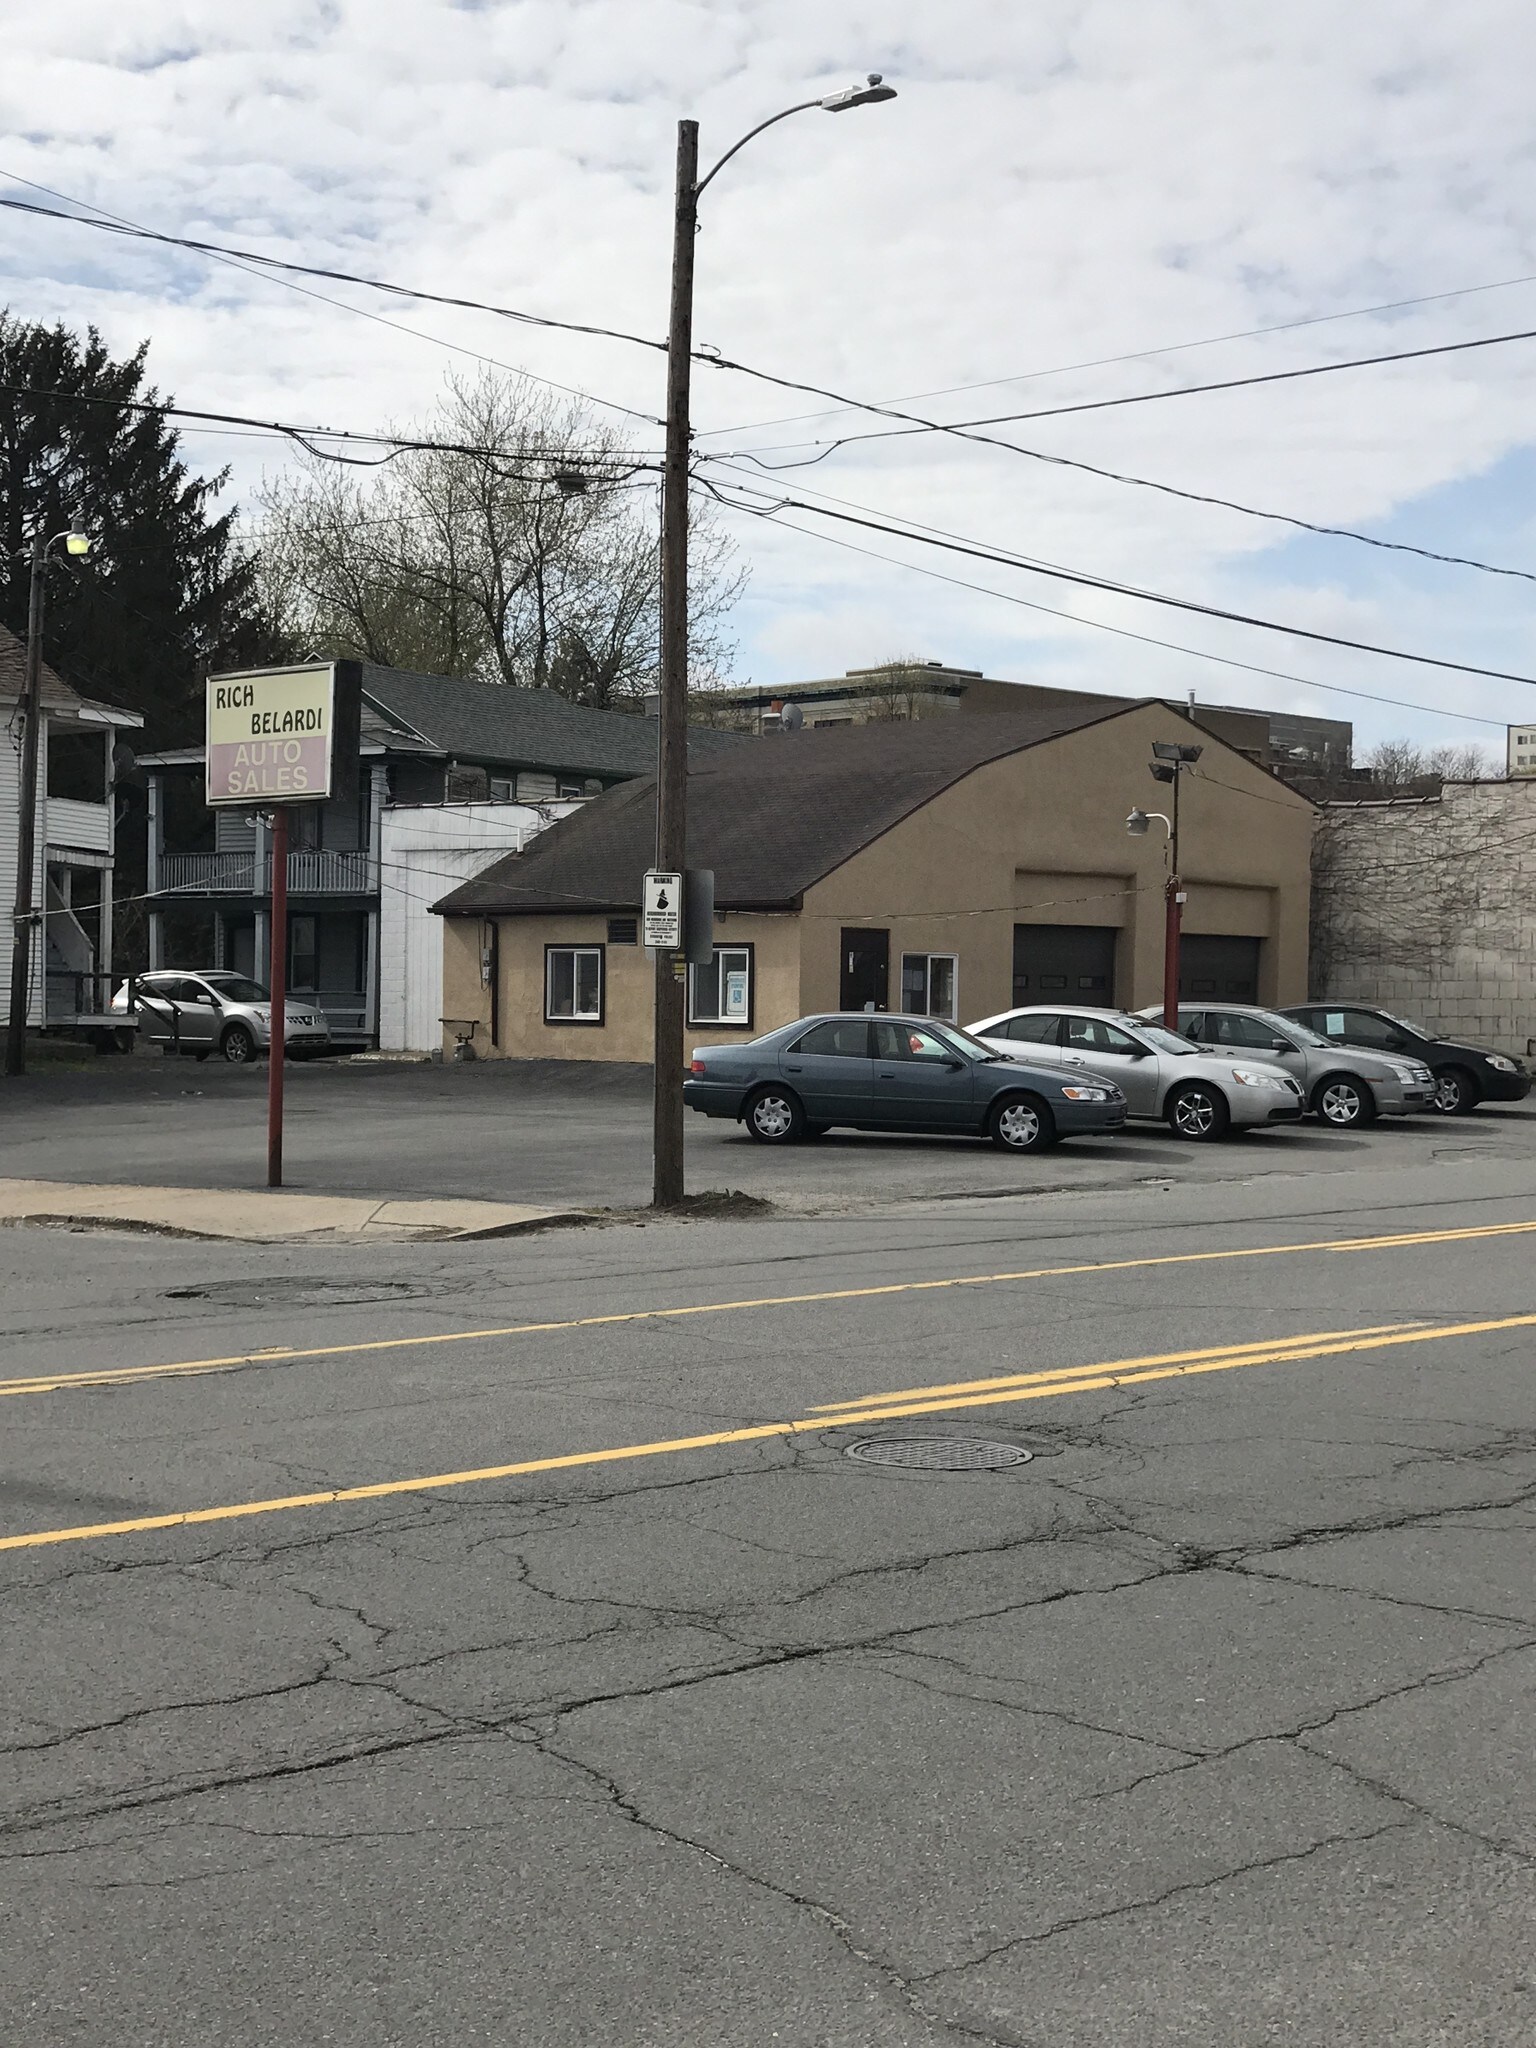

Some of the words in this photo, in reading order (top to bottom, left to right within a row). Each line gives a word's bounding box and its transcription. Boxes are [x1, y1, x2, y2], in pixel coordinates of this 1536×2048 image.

[216, 685, 254, 709] RICH
[251, 707, 323, 734] BELARDI
[234, 739, 302, 767] AUTO
[227, 765, 308, 794] SALES
